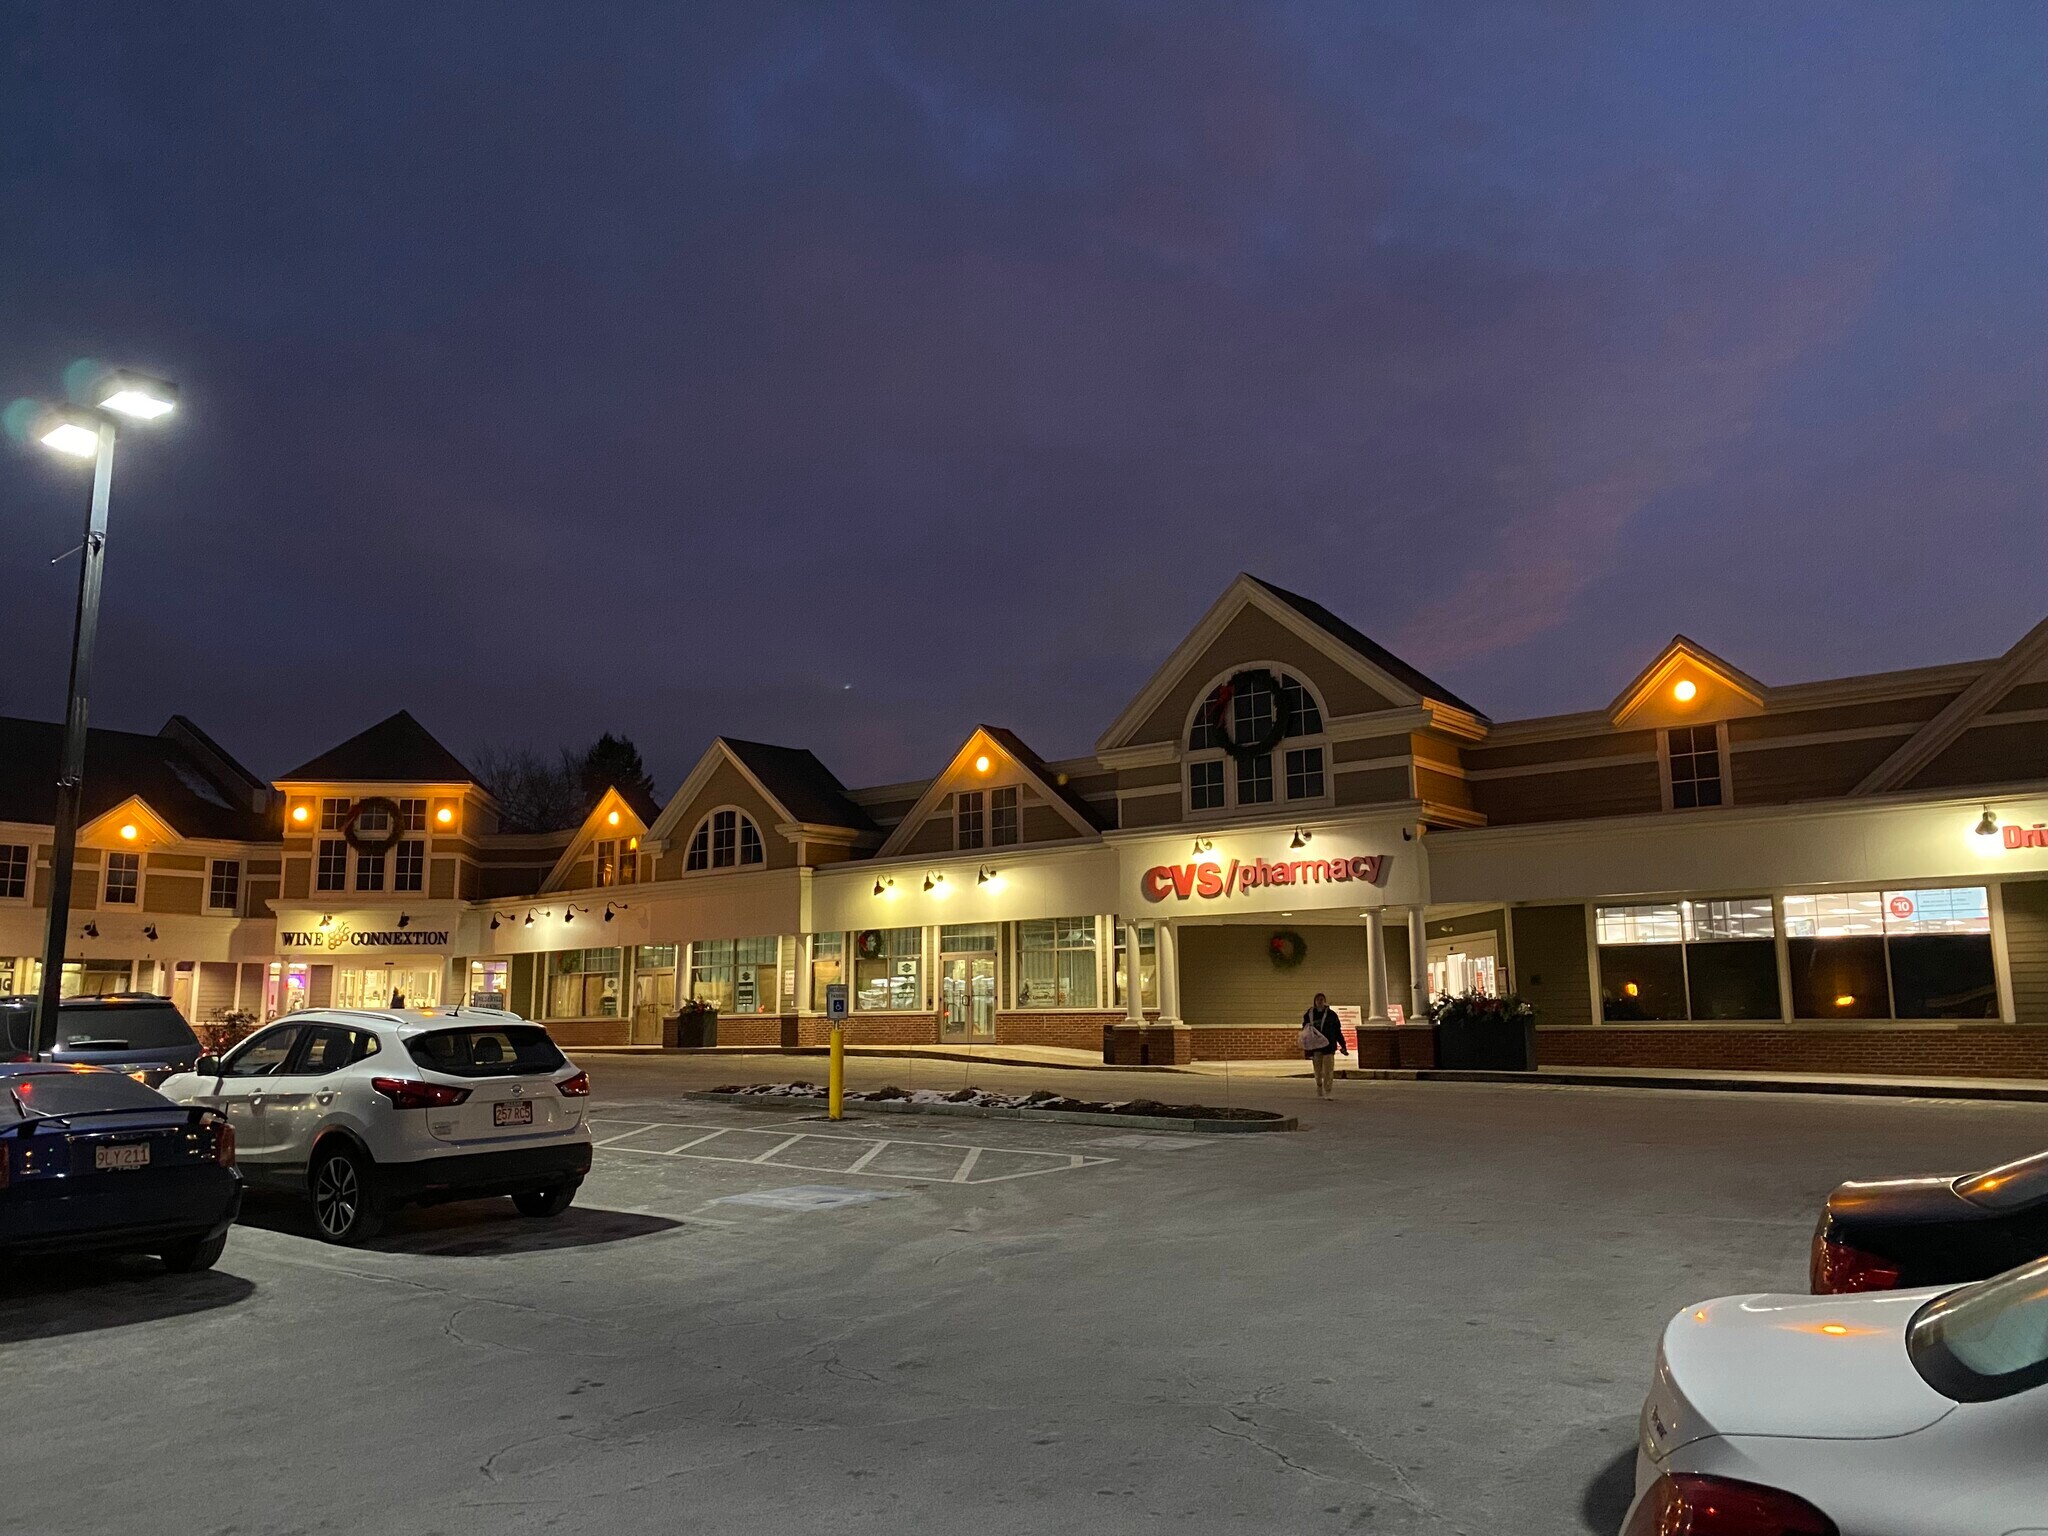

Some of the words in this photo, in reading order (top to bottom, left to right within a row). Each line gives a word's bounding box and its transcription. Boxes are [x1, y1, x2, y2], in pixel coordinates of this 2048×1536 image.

[282, 932, 324, 946] WINE
[350, 932, 449, 946] CONNEXTION
[496, 1108, 512, 1121] 257
[97, 1151, 120, 1166] 9LY
[124, 1149, 148, 1163] 211
